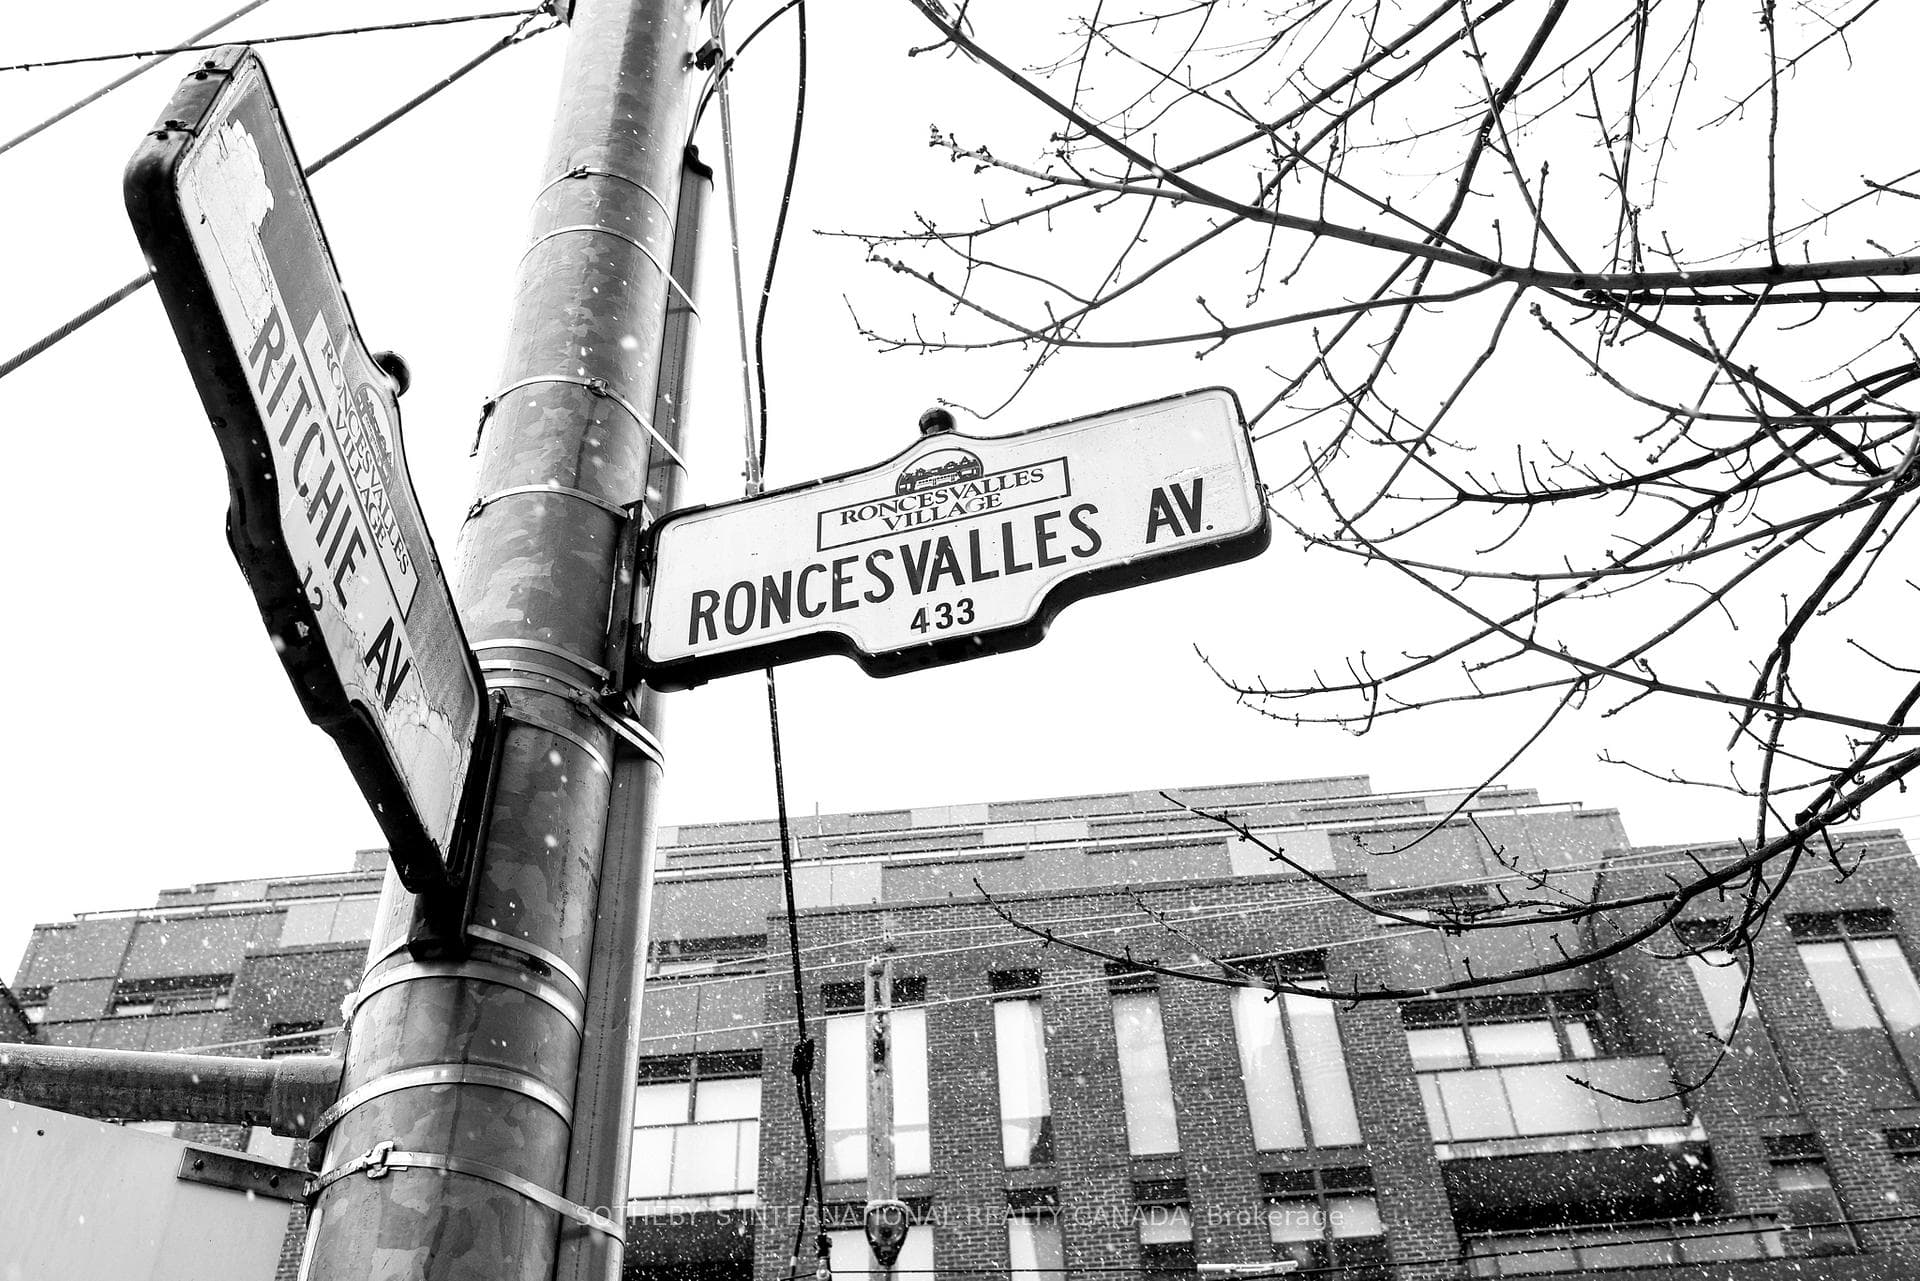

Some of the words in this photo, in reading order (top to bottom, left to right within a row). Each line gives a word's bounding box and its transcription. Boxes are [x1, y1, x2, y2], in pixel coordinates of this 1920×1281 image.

[248, 303, 367, 610] RITCHIE
[364, 615, 412, 712] AV
[321, 334, 409, 576] RONCESVALLES
[840, 467, 1045, 526] RONCESVALLES
[882, 493, 1003, 531] VILLAGE
[688, 503, 1102, 646] RONCESVALLES
[1145, 477, 1214, 544] AV.
[910, 597, 975, 635] 433
